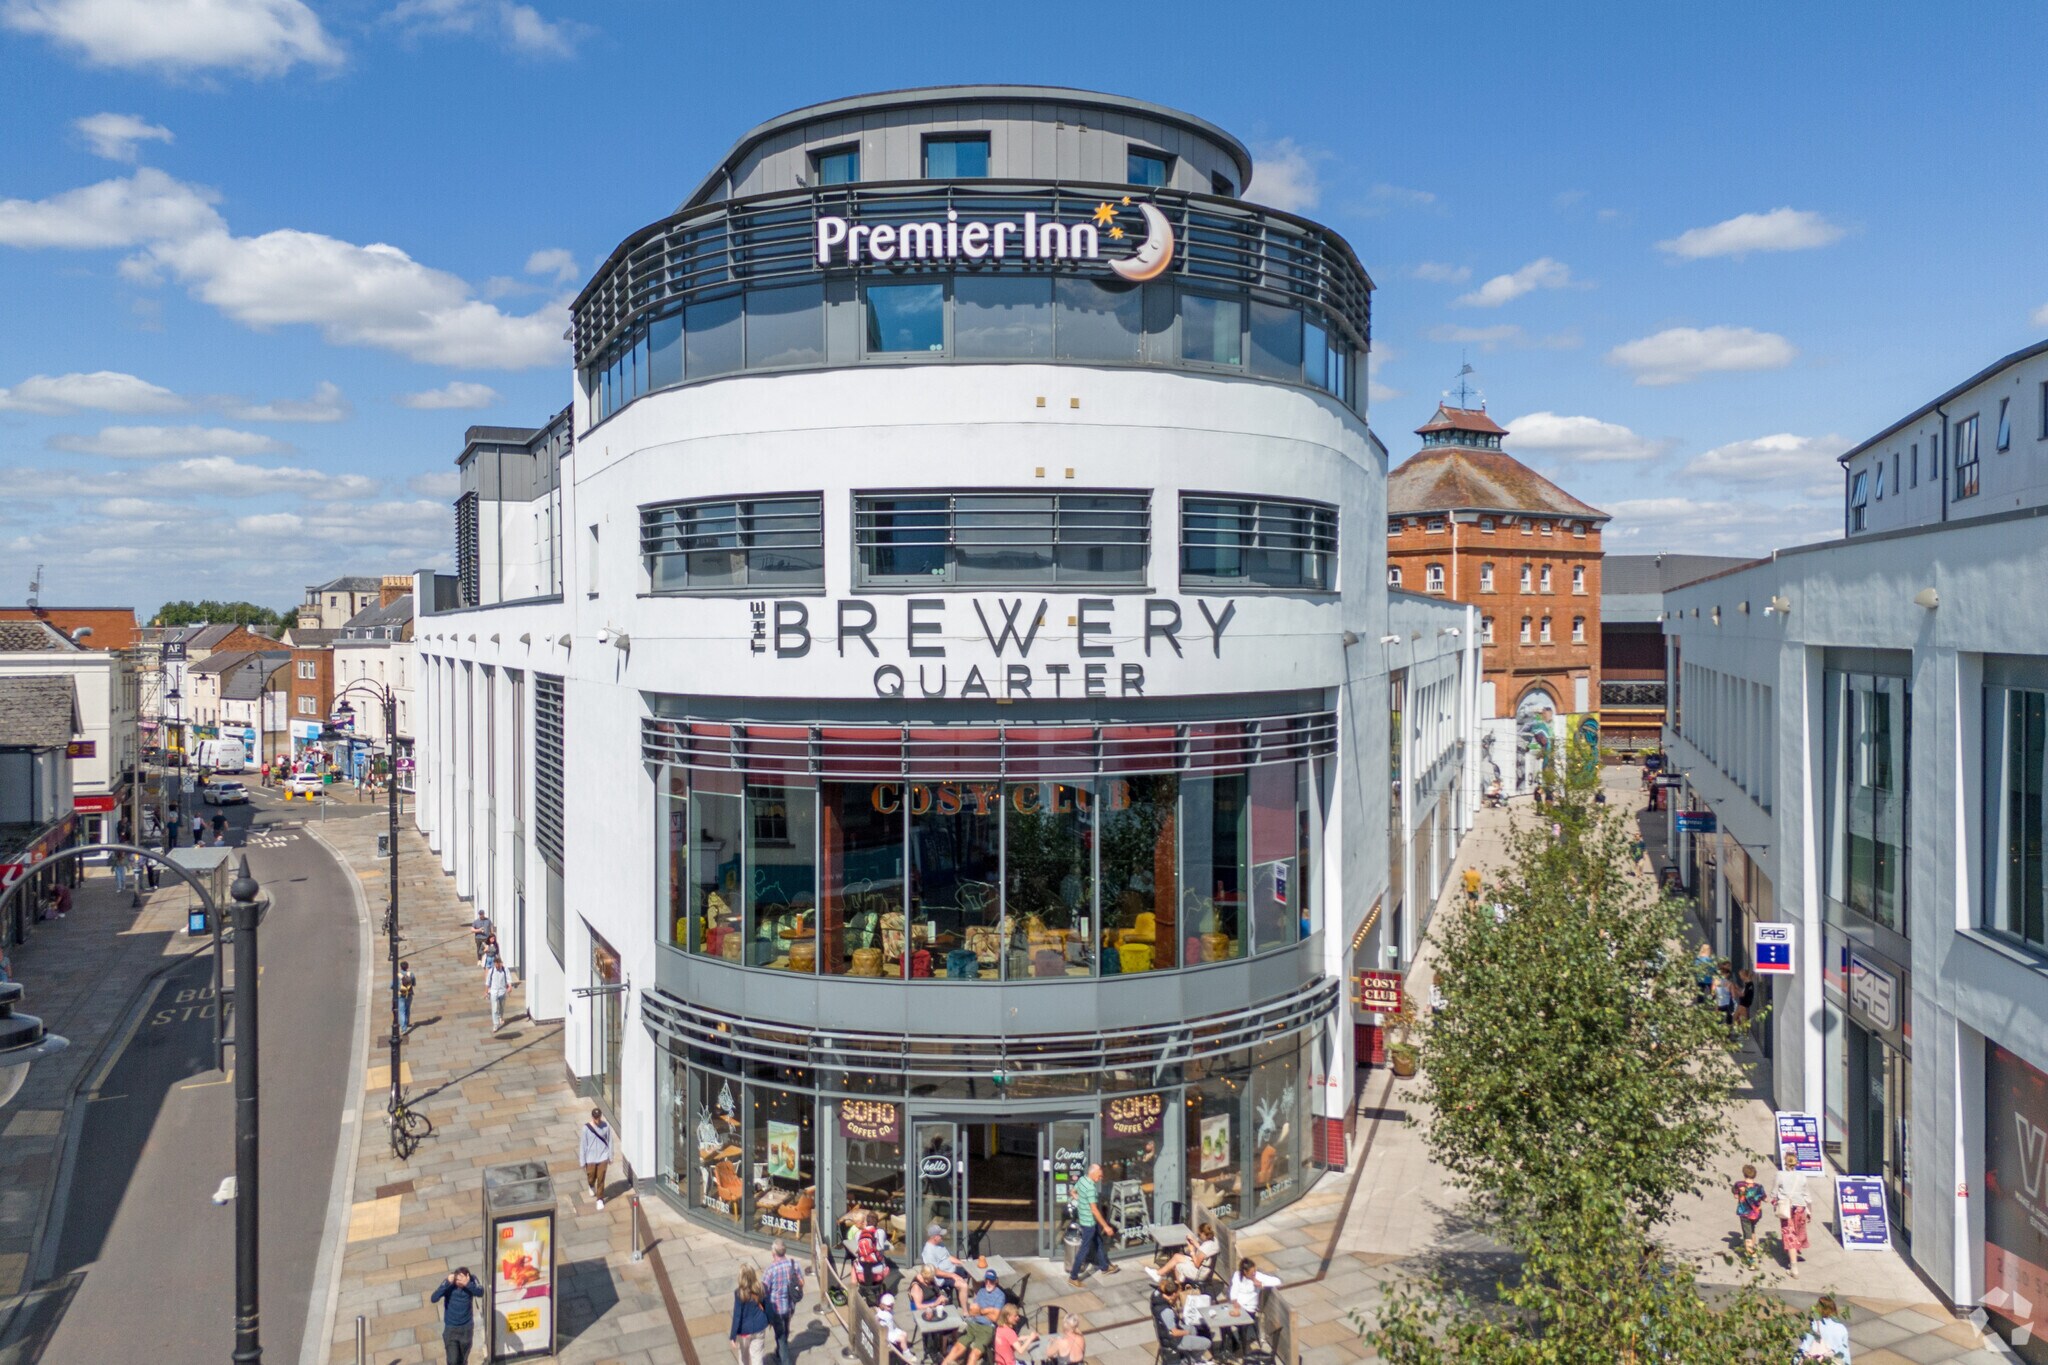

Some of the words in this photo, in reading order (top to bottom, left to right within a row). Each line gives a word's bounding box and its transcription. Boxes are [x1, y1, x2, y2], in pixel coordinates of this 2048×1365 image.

[818, 210, 1016, 263] Premier
[1024, 211, 1099, 258] Inn
[750, 600, 766, 658] THE
[774, 598, 1235, 659] BREWERY
[873, 663, 1146, 698] QUARTER
[871, 782, 998, 815] COSY
[1012, 780, 1131, 815] CLUB
[1760, 928, 1787, 939] F45
[1364, 977, 1398, 990] COSY
[1851, 955, 1894, 1029] F45
[175, 986, 216, 1003] BU
[1364, 989, 1398, 1001] CLUB
[841, 1099, 895, 1124] SOHO
[1109, 1094, 1161, 1121] SOHO
[847, 1122, 878, 1138] COFFEE
[1113, 1122, 1142, 1134] COFFEE
[1055, 1147, 1085, 1160] Come
[923, 1160, 946, 1171] hello
[1054, 1162, 1067, 1170] on
[702, 1195, 730, 1214] JUICES
[761, 1214, 800, 1232] SHAKES
